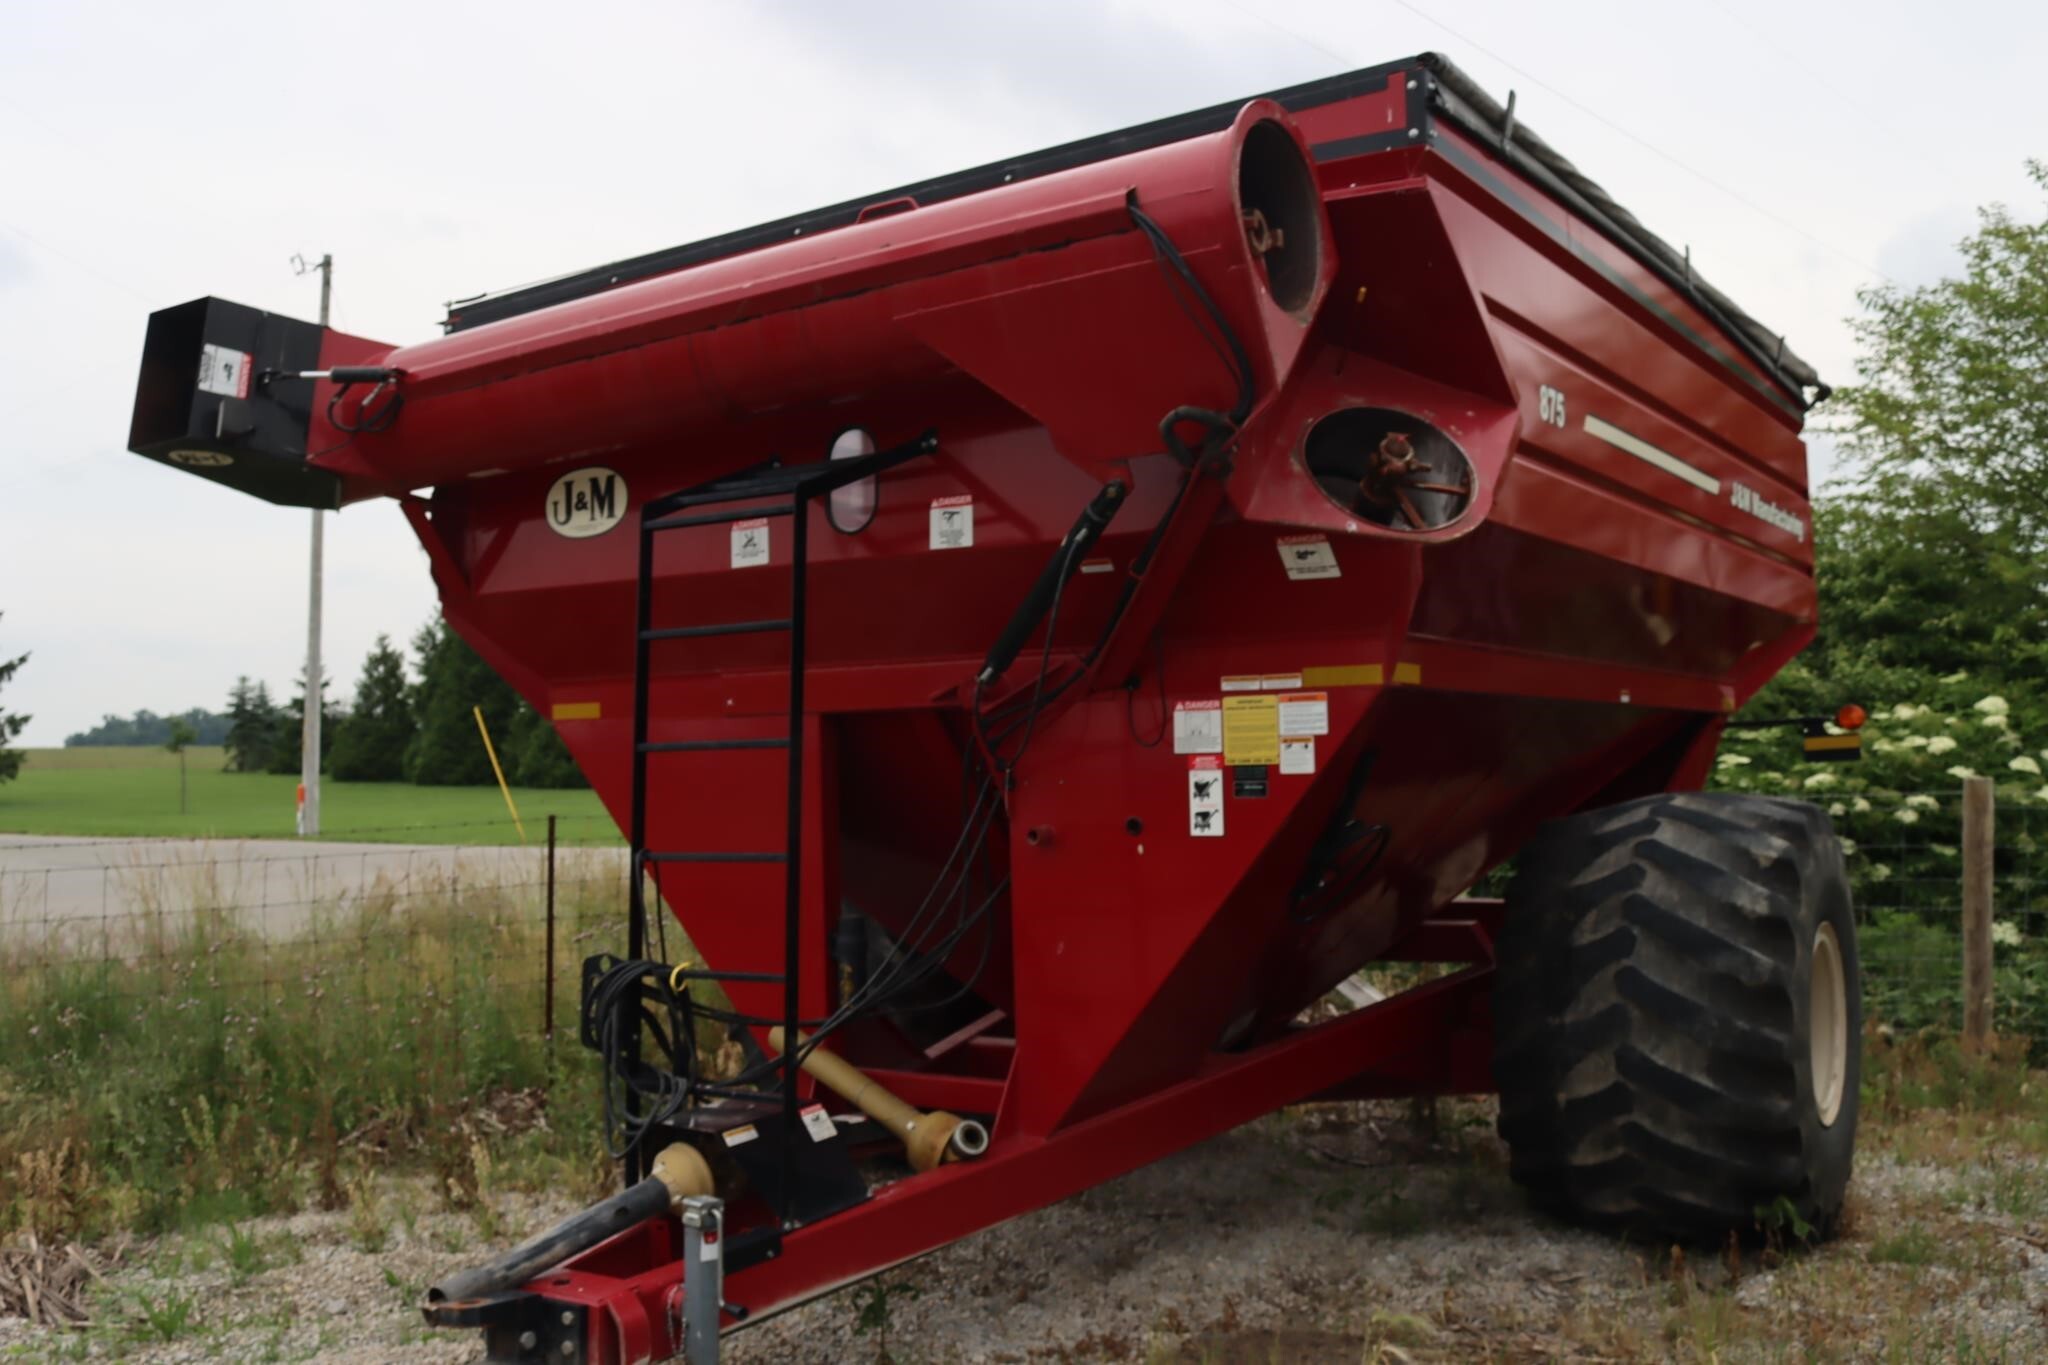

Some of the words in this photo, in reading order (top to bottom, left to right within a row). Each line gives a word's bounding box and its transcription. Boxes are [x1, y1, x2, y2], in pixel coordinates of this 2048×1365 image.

[1539, 384, 1566, 428] 875
[553, 475, 616, 526] J&M
[1184, 700, 1220, 710] DANGER
